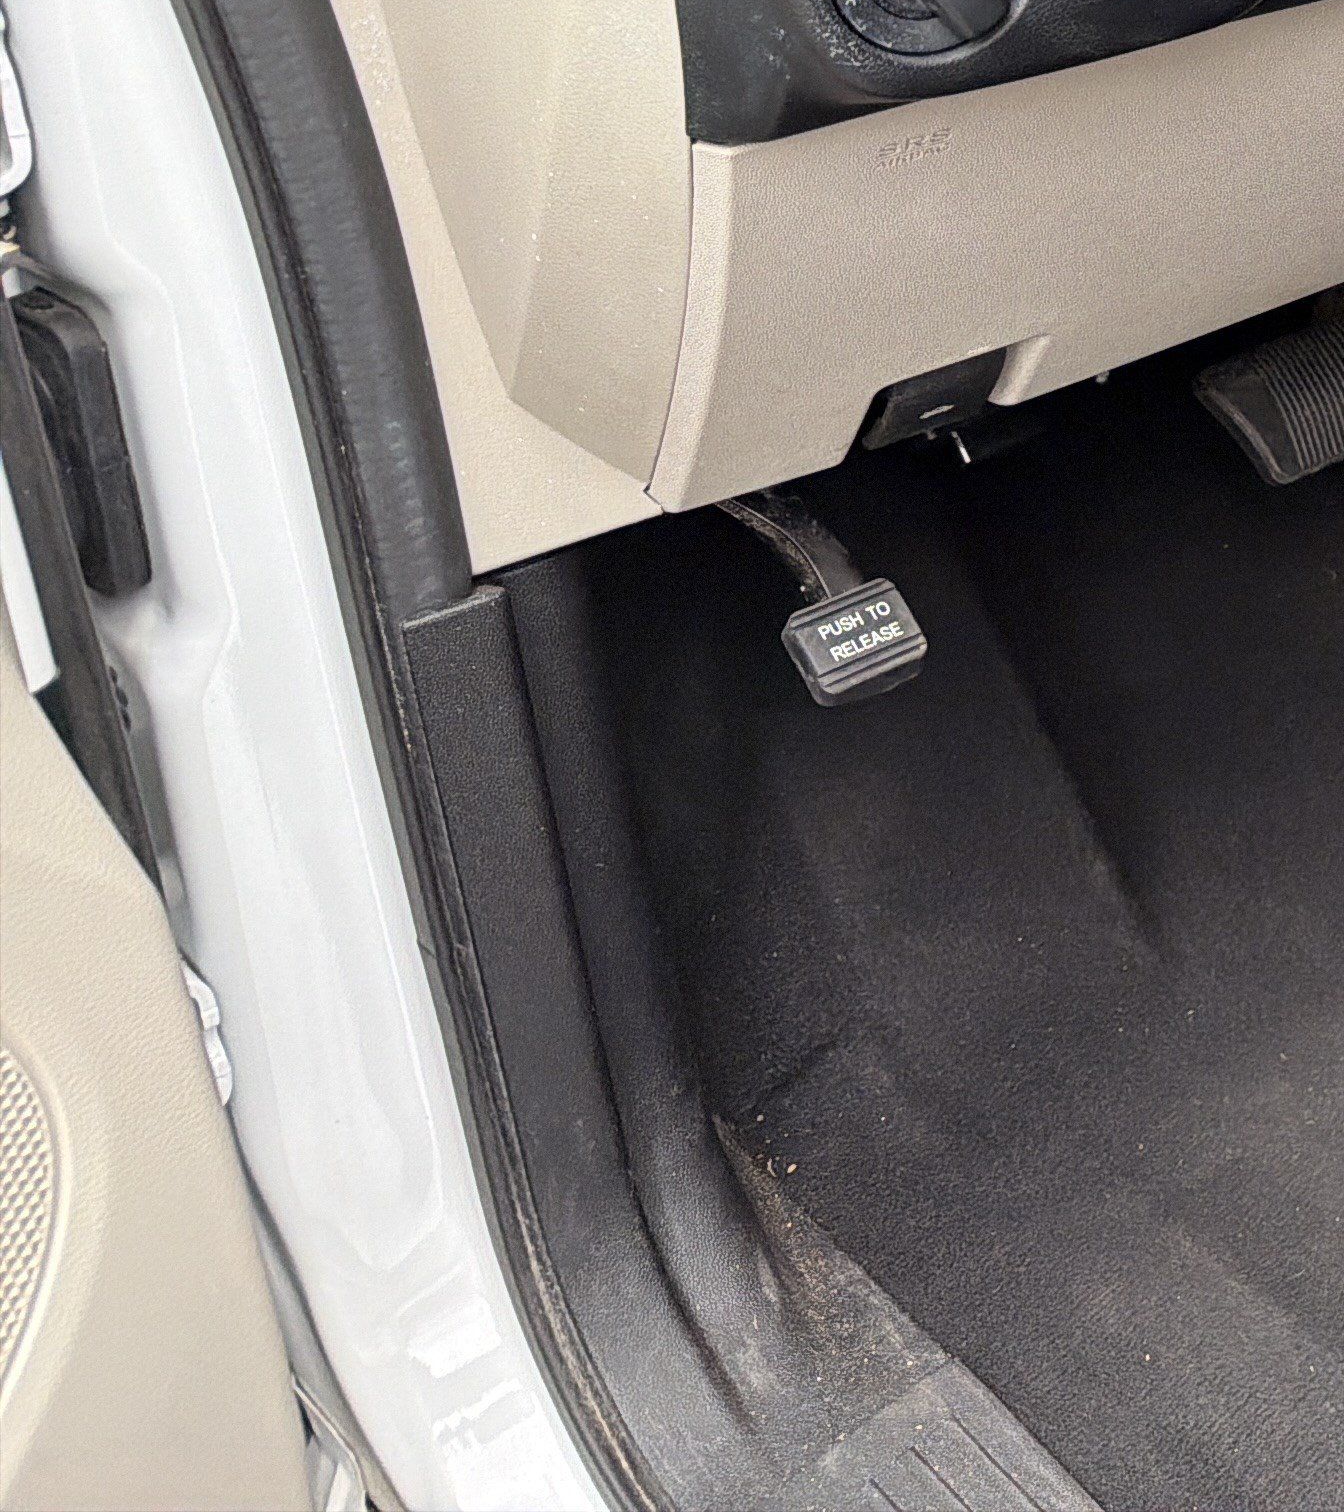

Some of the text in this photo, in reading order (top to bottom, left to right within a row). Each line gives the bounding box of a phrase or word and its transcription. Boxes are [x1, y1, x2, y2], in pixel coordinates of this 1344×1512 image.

[878, 127, 952, 156] SRS
[818, 601, 891, 640] PUSH TO
[829, 621, 904, 662] RELEASE
